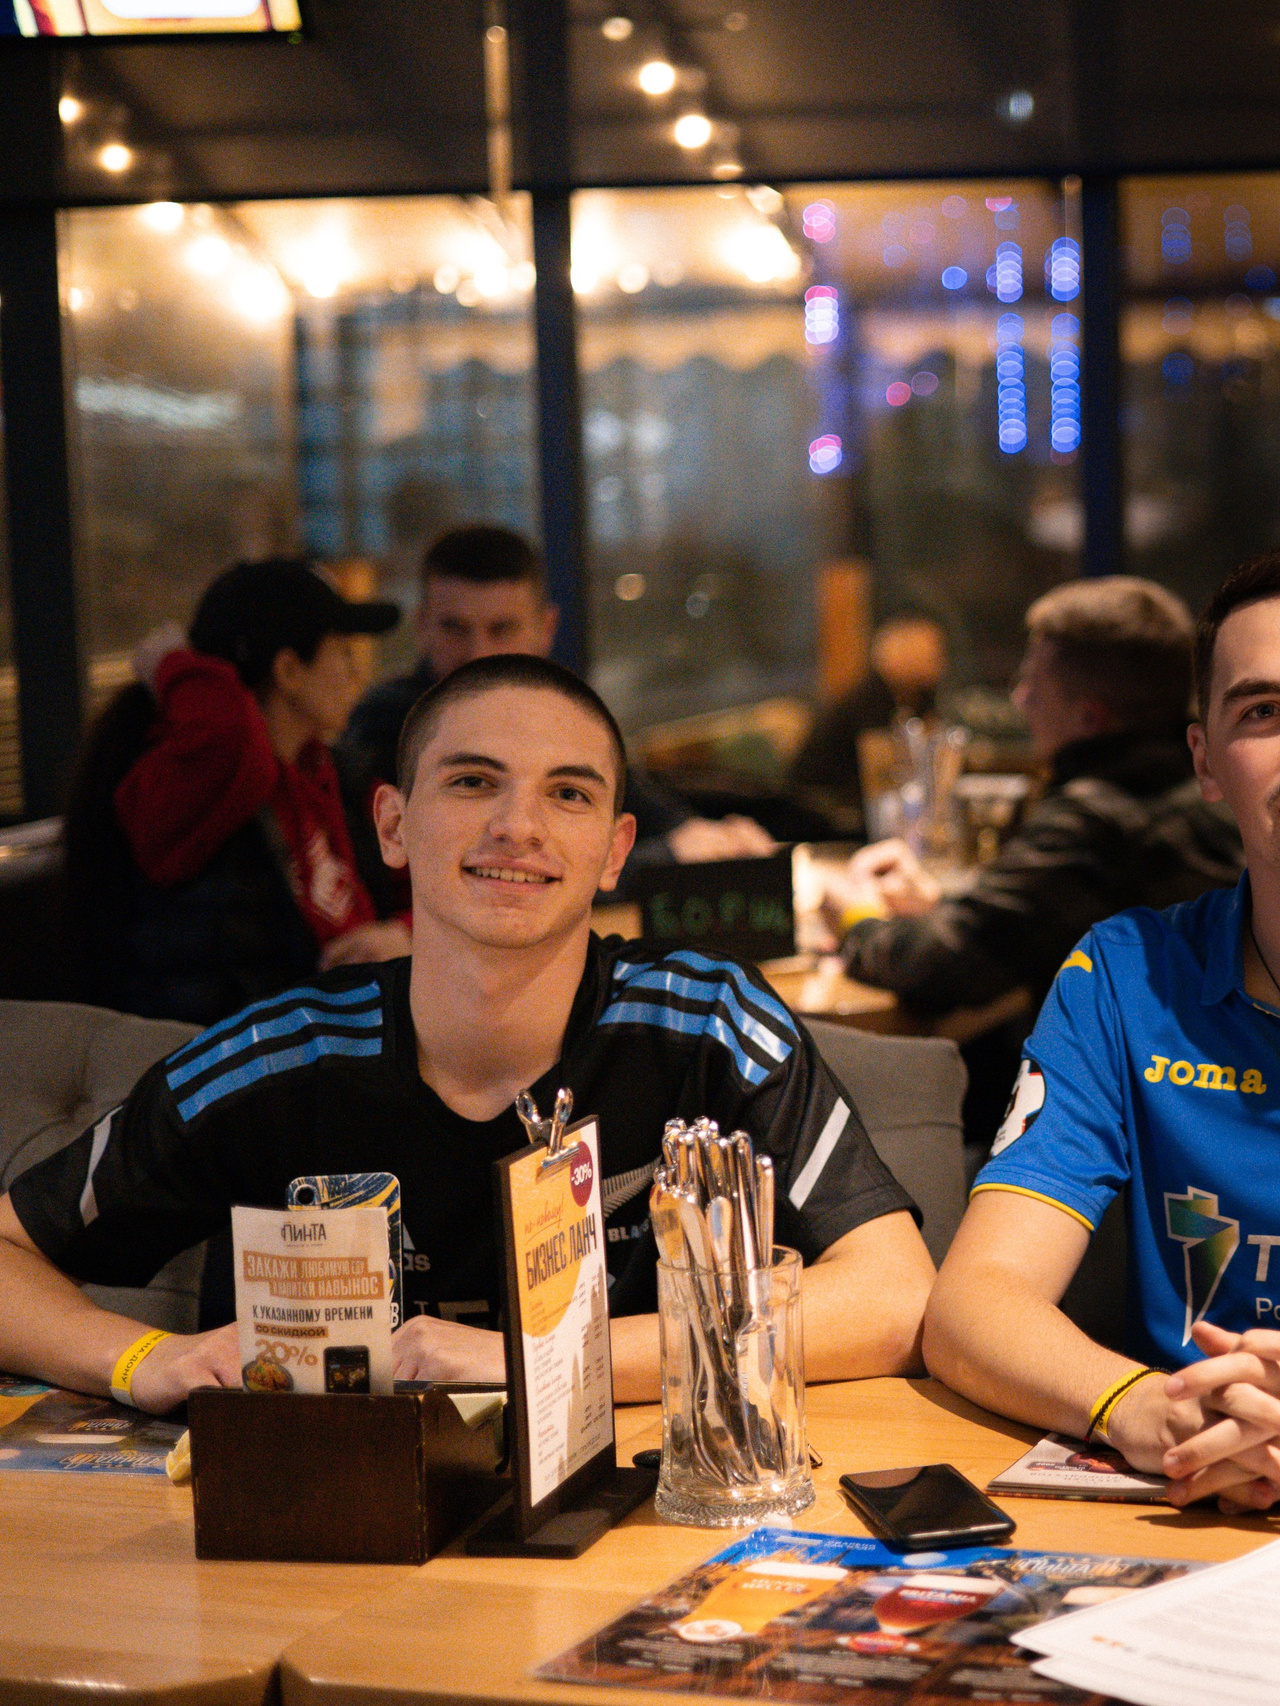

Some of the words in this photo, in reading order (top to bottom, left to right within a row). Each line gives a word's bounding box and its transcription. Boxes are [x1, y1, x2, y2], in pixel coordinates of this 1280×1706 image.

[570, 1162, 593, 1187] -30%
[525, 1230, 567, 1291] БИЗНЕС
[568, 1212, 598, 1265] ЛАНЧ
[247, 1256, 299, 1279] ЗАКАЖИ
[318, 1276, 380, 1298] НАВЫНОС
[253, 1304, 259, 1319] К
[260, 1305, 322, 1323] УКАЗАННОМУ
[325, 1305, 374, 1322] ВРЕМЕНИ
[254, 1339, 319, 1367] 20%
